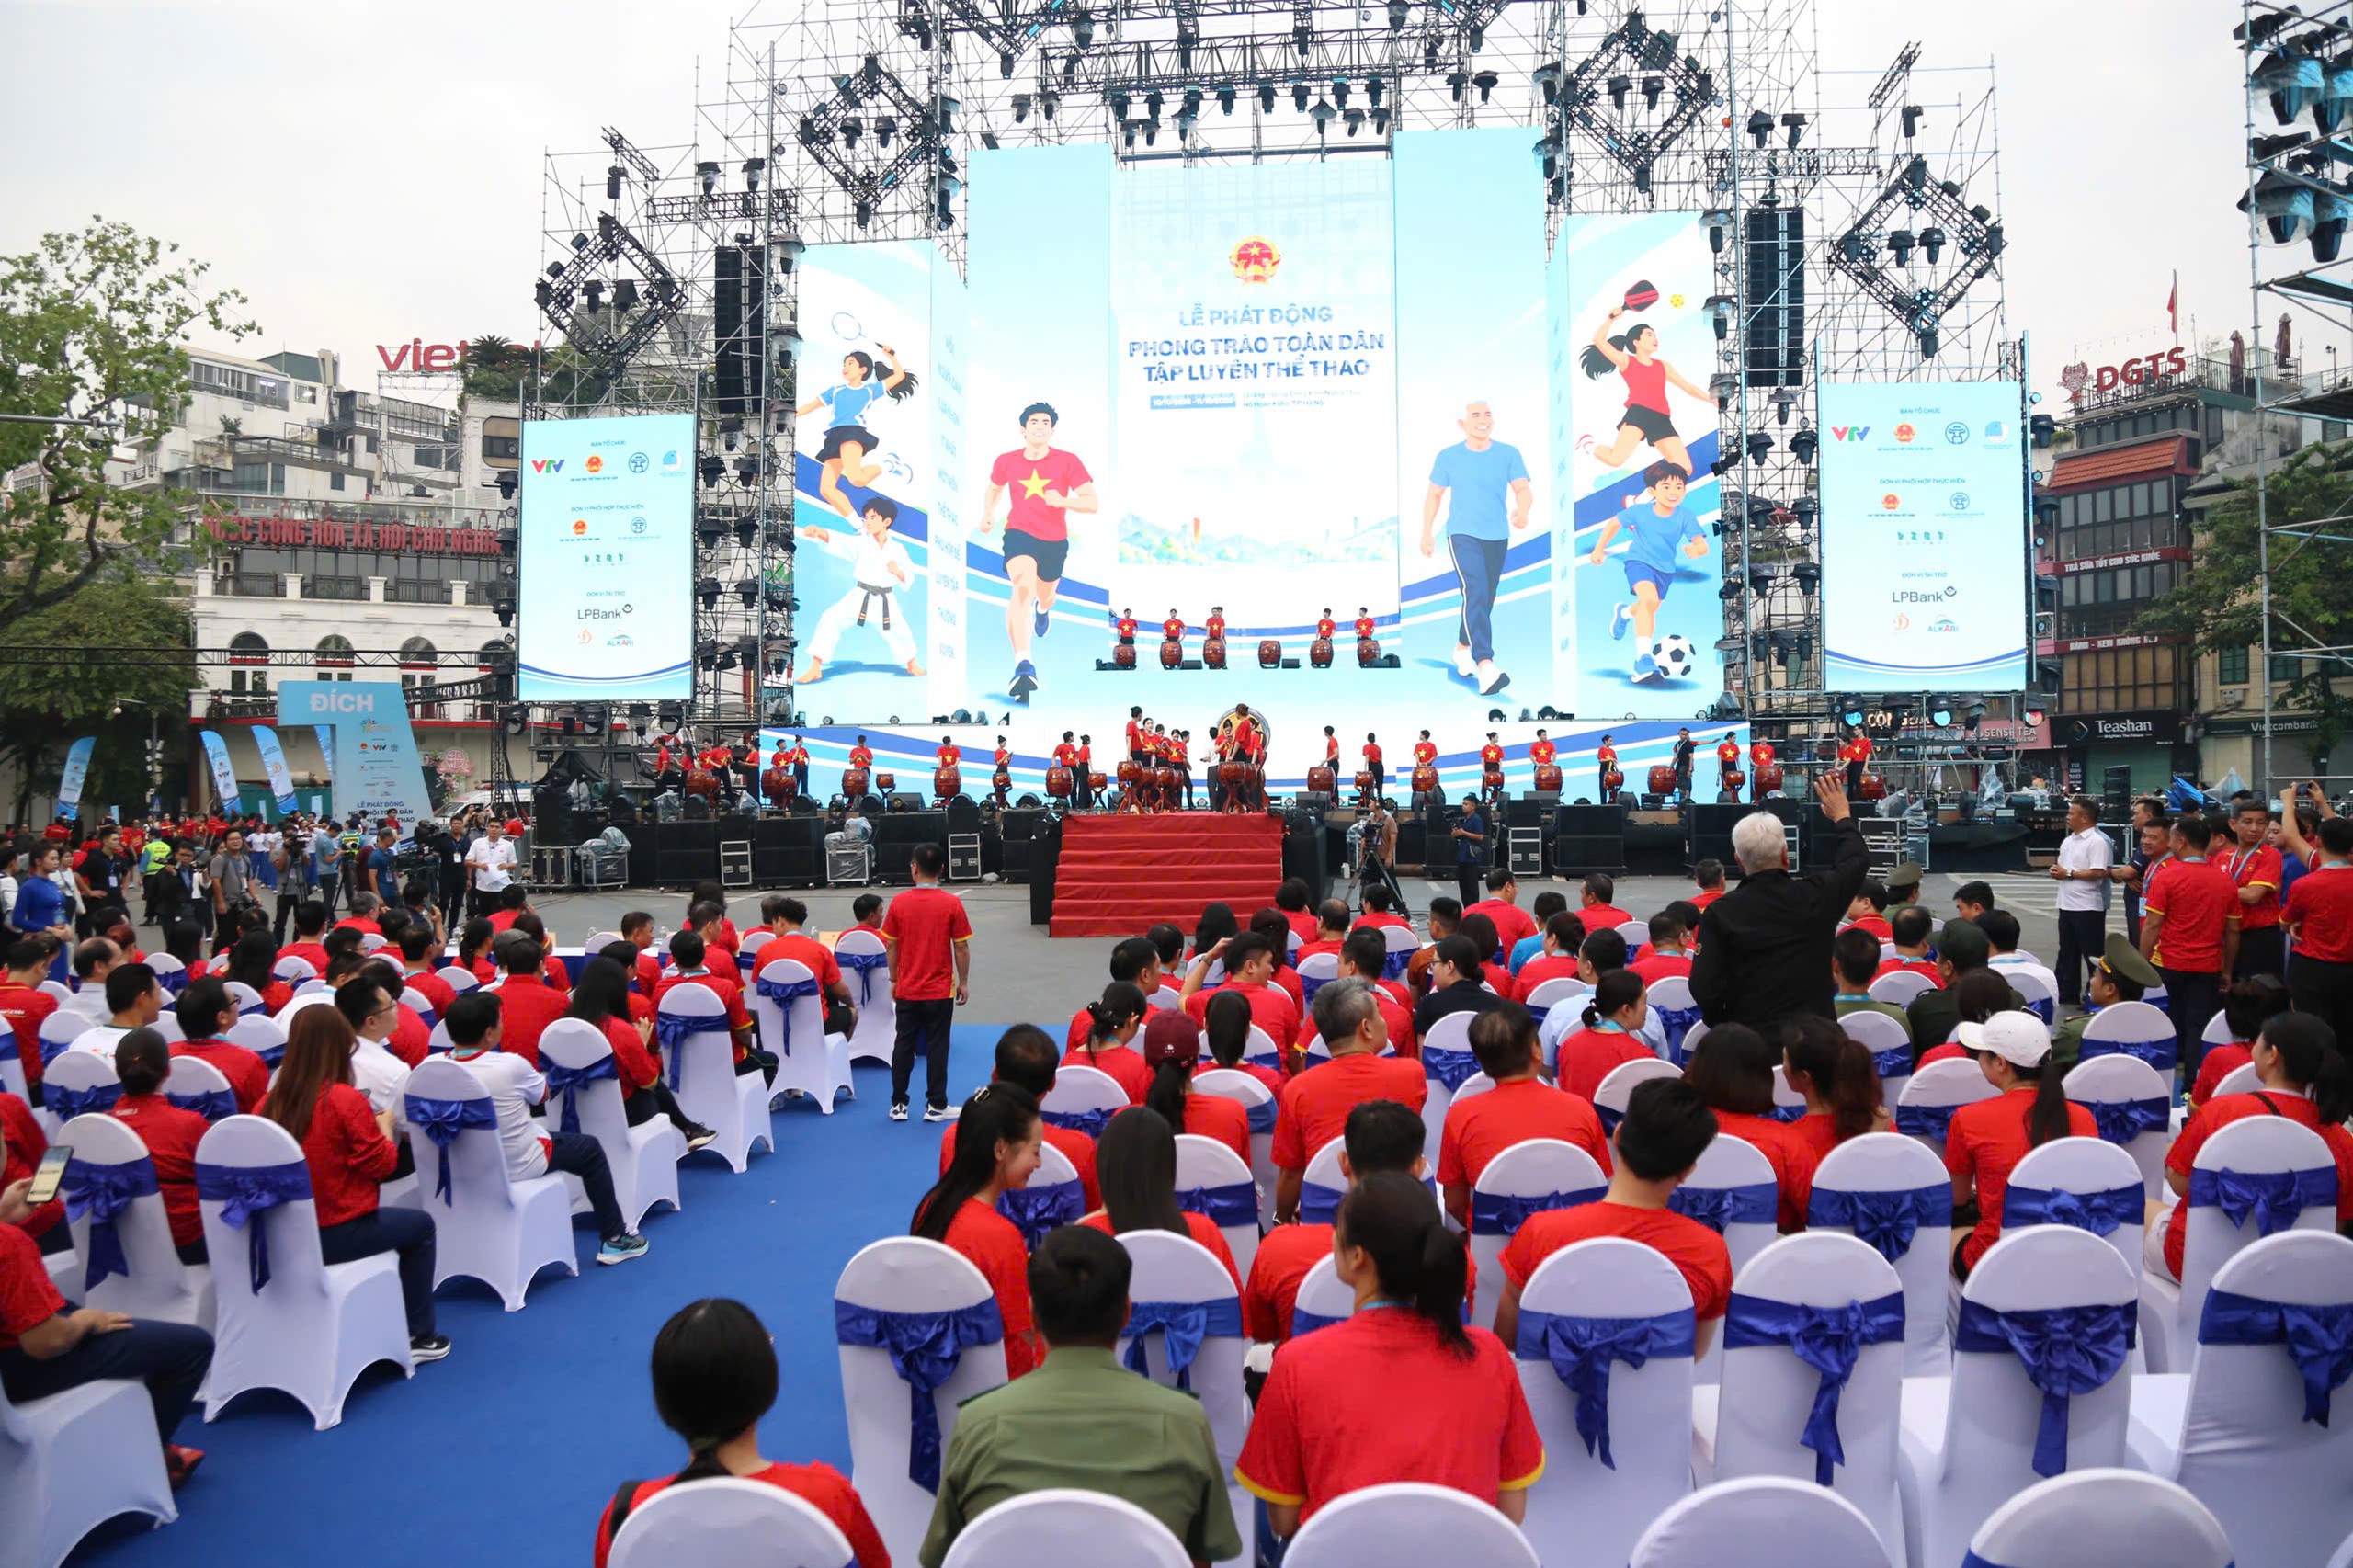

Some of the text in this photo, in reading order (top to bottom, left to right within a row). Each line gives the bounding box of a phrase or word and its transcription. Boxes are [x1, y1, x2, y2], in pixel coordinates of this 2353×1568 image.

[1179, 302, 1333, 326] LỄ PHÁT ĐỘNG
[1129, 330, 1384, 357] PHONG TRÀO TOÀN DÂN
[1142, 354, 1370, 384] TẬP LUYỆN THỂ THAO
[2096, 347, 2187, 392] DGTS
[1831, 426, 1870, 441] VTV
[531, 459, 565, 474] VTV
[258, 511, 307, 551] CỘNG
[311, 514, 346, 547] HÒA
[353, 517, 374, 548] XÃ
[379, 517, 407, 556] HỘI
[412, 519, 446, 551] CHỦ
[2064, 562, 2079, 572] TRÀ
[2109, 557, 2124, 567] CHO
[1893, 591, 1943, 603] LPBank
[577, 608, 621, 619] LPBank
[1927, 624, 1959, 632] ALKARI
[309, 689, 374, 712] ĐÍCH
[1985, 726, 2037, 737] SENSE TEA
[2095, 719, 2152, 733] Teashan
